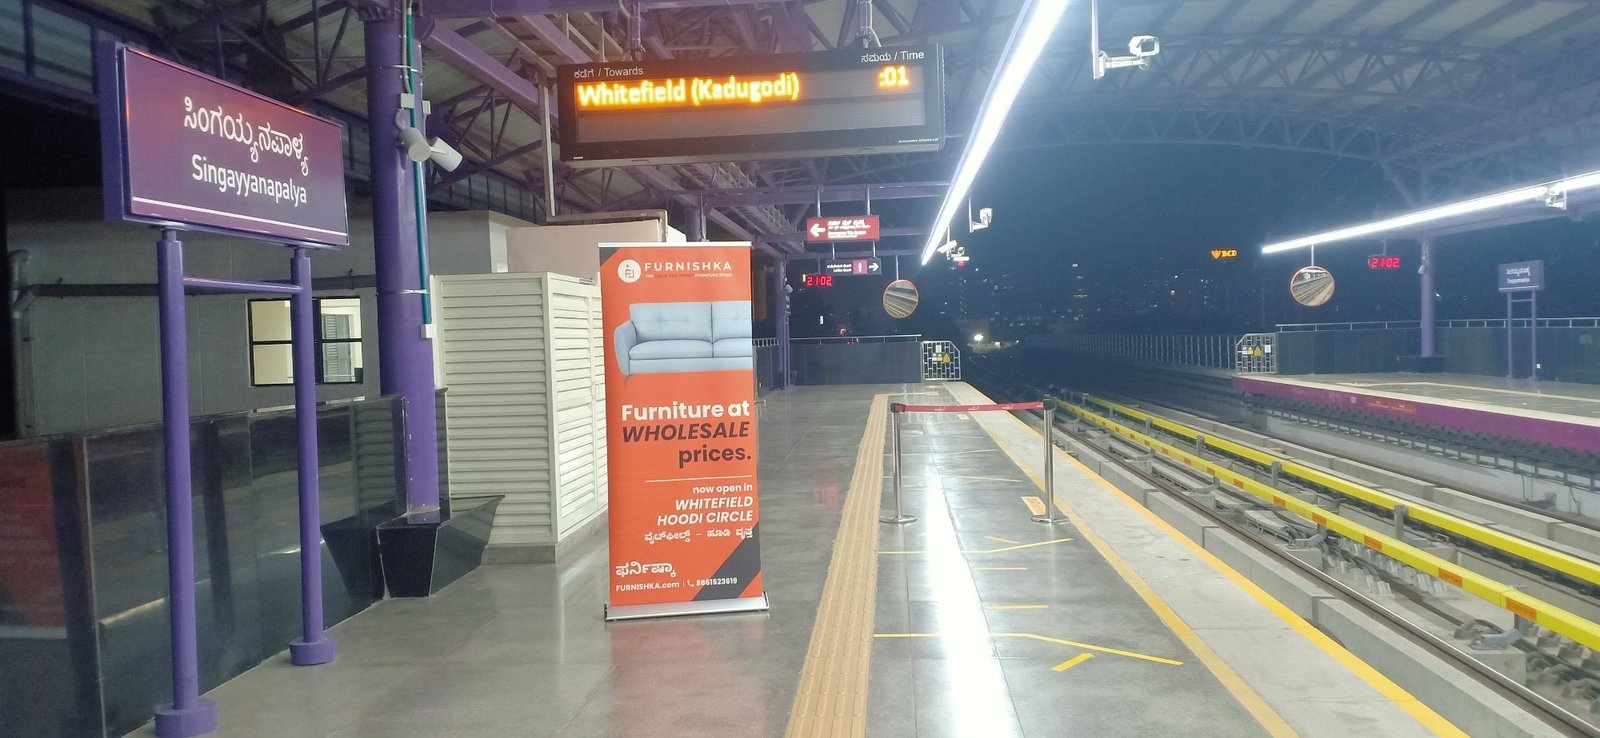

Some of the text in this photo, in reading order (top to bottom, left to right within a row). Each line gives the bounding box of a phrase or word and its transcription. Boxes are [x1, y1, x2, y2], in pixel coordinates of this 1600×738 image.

[861, 52, 891, 62] ಸಮಯ
[900, 50, 925, 60] Time
[604, 66, 644, 77] Towards
[577, 79, 686, 107] Whitefield
[691, 72, 800, 106] (Kadugodi)
[184, 97, 309, 176] ಸಿಂಗಯ್ಯನಪಾಳ್ಯ
[192, 154, 307, 207] Singayyanapalya
[644, 261, 733, 272] FURNISHKA
[807, 276, 832, 287] 21:02
[621, 400, 750, 421] Furniture at
[622, 421, 750, 442] WHOLESALE
[679, 444, 752, 469] prices.
[693, 483, 753, 495] now open in
[675, 496, 753, 511] WHITEFIELD
[657, 510, 753, 526] HOODI CIRCLE
[615, 581, 680, 592] FURNISHKA.com
